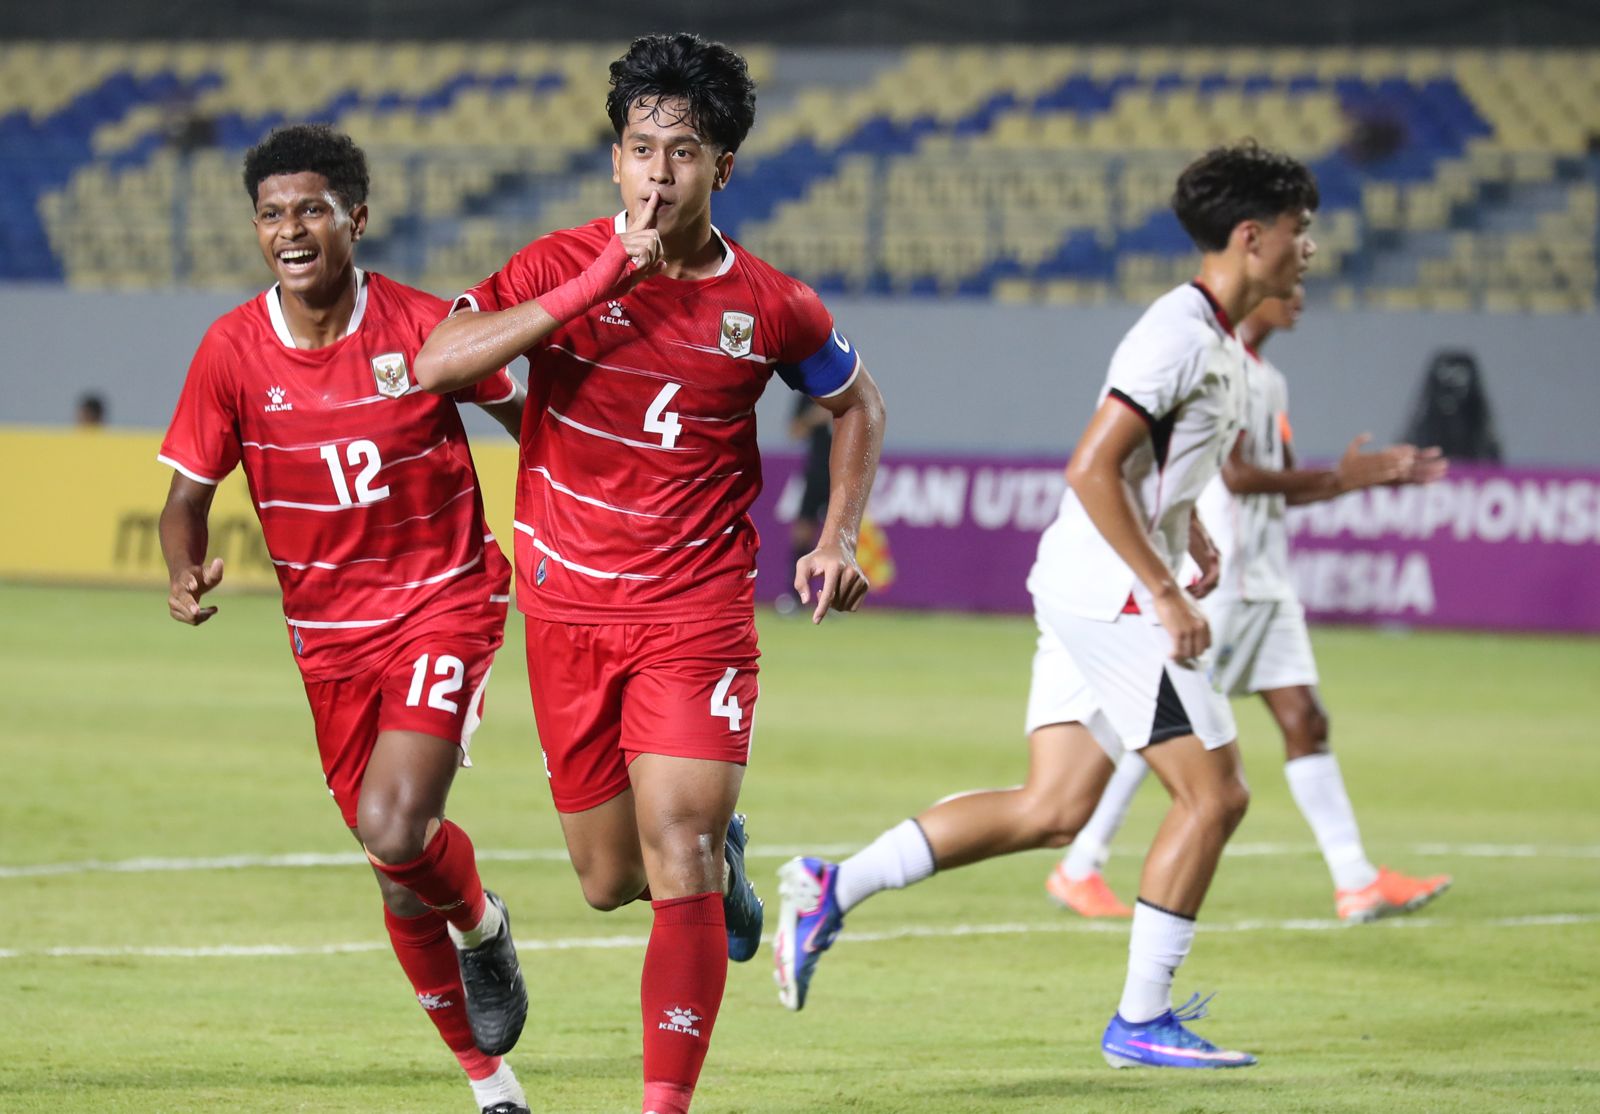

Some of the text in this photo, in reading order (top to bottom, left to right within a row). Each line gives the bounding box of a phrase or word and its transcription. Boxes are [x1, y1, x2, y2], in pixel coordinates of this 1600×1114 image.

[600, 315, 631, 327] KELME
[264, 403, 293, 413] KELME
[643, 382, 683, 449] 4
[319, 439, 390, 506] 12
[1283, 477, 1600, 546] HAMPIONS
[405, 653, 465, 715] 12
[710, 666, 743, 731] 4
[658, 1022, 700, 1037] KELME
